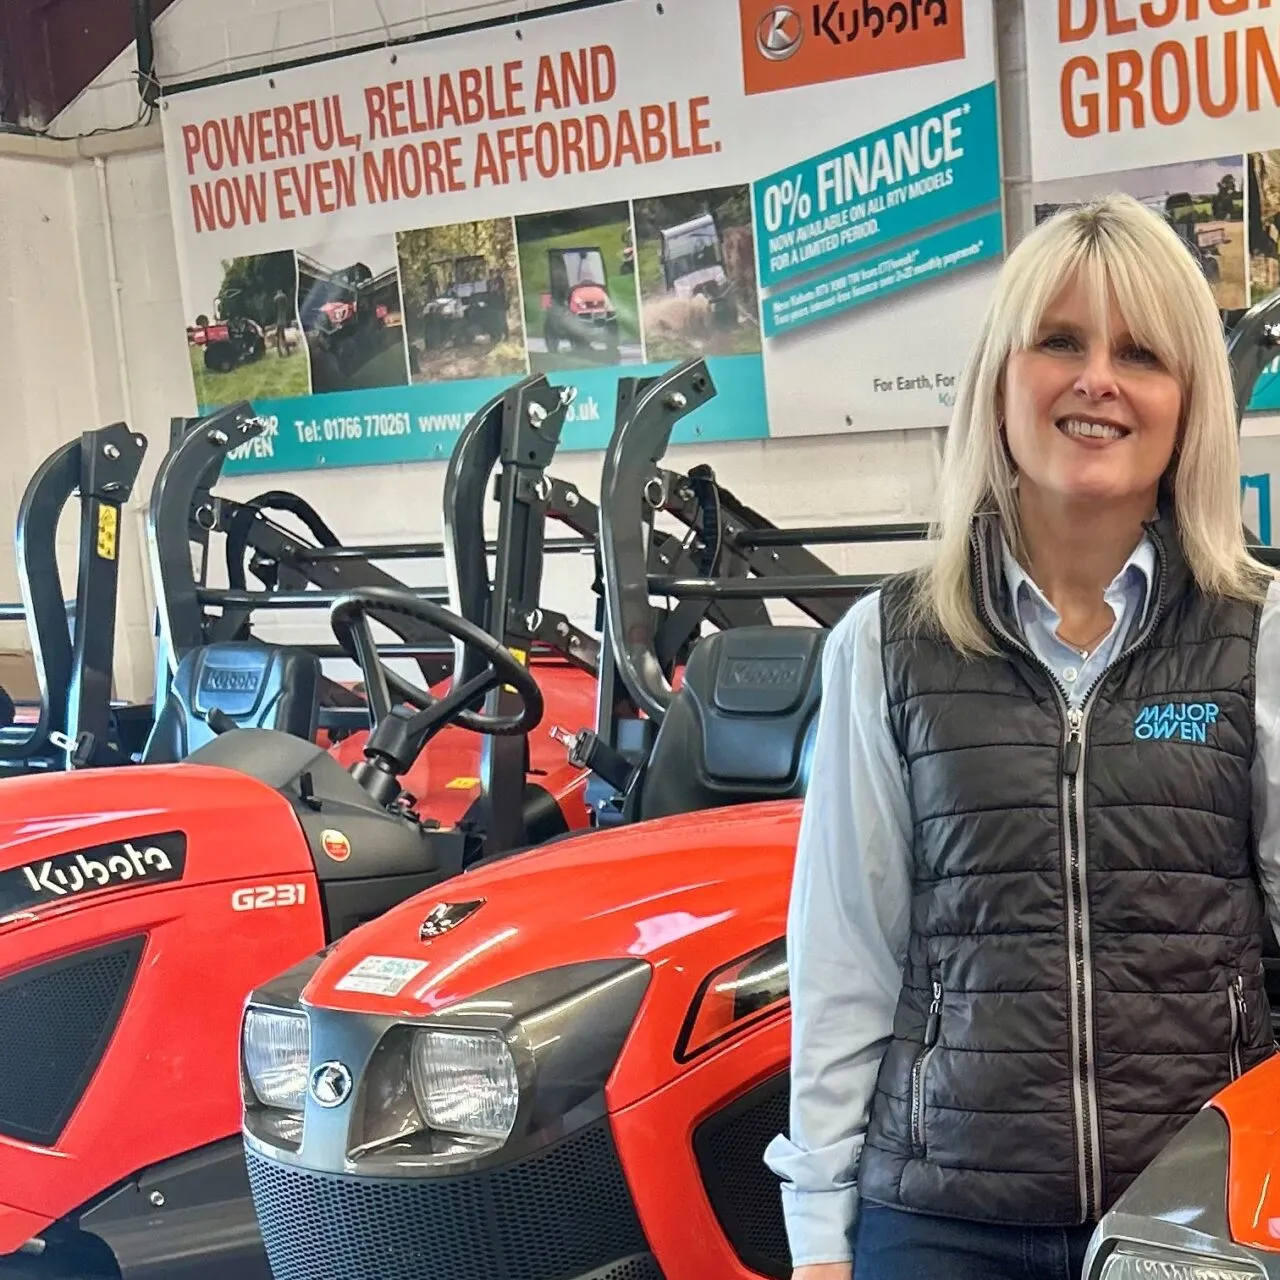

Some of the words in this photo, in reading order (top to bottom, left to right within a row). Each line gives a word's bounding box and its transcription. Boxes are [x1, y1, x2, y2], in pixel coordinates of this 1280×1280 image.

[813, 0, 948, 45] Kubota
[182, 94, 362, 175] POWERFUL,
[364, 60, 526, 140] RELIABLE
[534, 44, 616, 113] AND
[190, 172, 266, 233] NOW
[274, 156, 356, 220] EVEN
[363, 136, 466, 205] MORE
[474, 95, 722, 188] AFFORDABLE.
[763, 174, 811, 232] 0%
[769, 232, 796, 254] NOW
[796, 209, 848, 244] AVAILABLE
[850, 202, 867, 222] ON
[867, 197, 886, 216] ALL
[887, 188, 908, 209] RTV
[908, 168, 954, 200] MODELS
[769, 252, 790, 273] FOR
[788, 249, 799, 267] A
[799, 232, 839, 262] LIMITED
[840, 217, 881, 247] PERIOD.
[873, 377, 893, 393] For
[896, 374, 934, 391] Earth,
[935, 373, 955, 388] For
[294, 419, 322, 443] Tel:
[323, 415, 363, 441] 01766
[363, 411, 412, 438] 770261
[1134, 703, 1220, 724] MAJOR
[1135, 721, 1207, 743] OWEN
[23, 843, 173, 895] Kubota
[232, 883, 306, 912] G231
